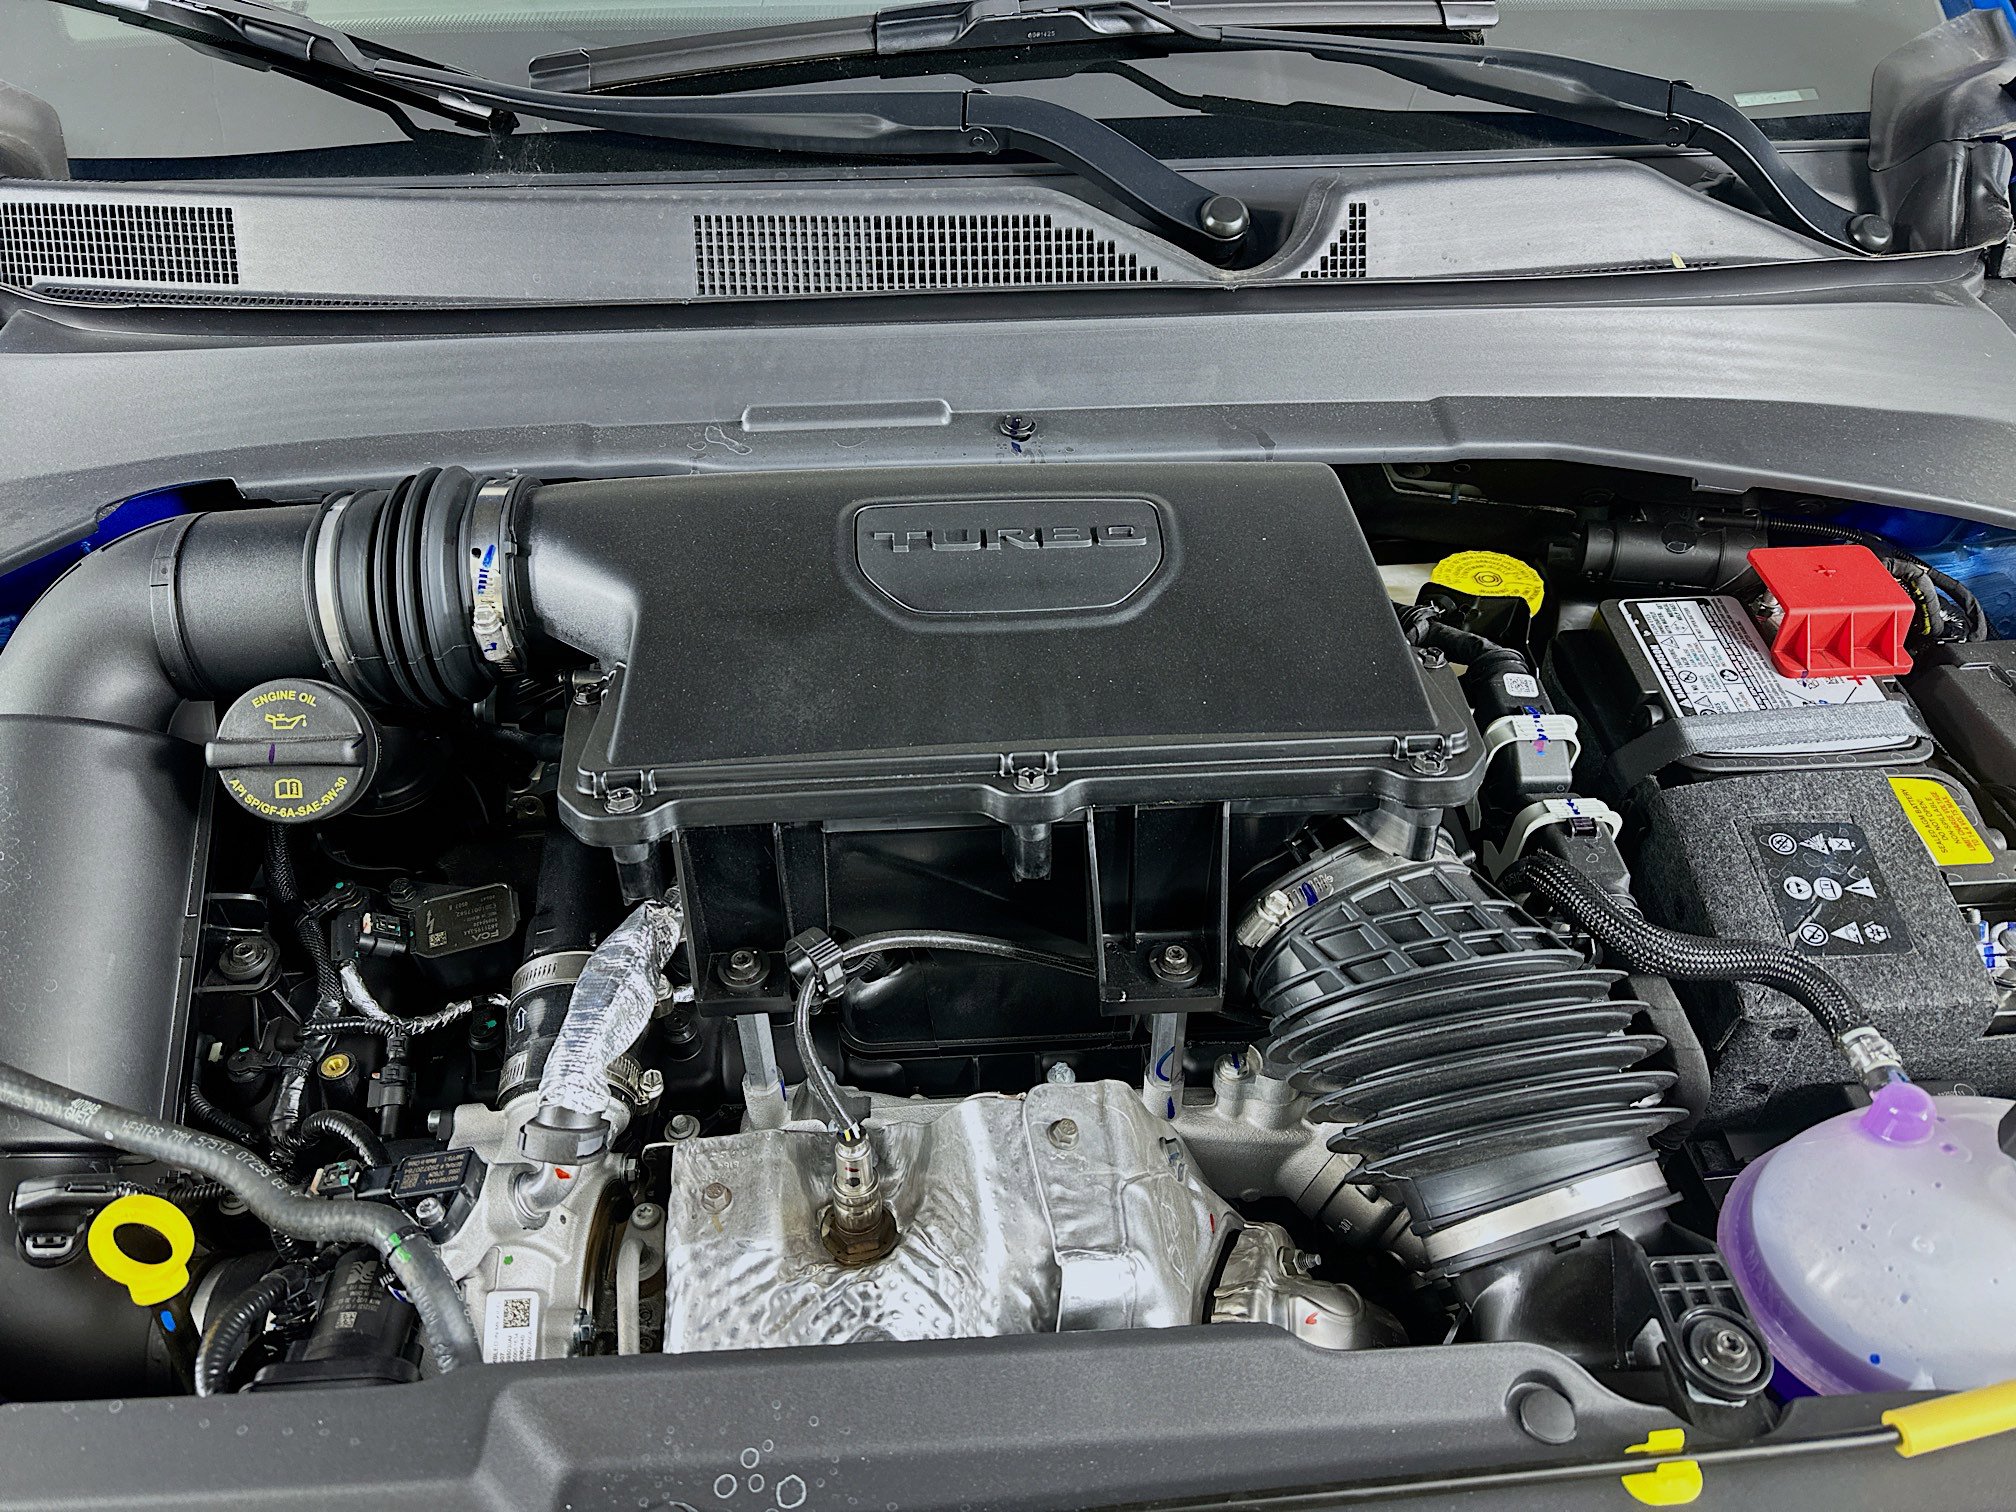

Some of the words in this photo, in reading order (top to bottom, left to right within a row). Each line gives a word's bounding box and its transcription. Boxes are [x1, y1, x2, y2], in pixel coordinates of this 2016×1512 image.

[873, 525, 1148, 552] TURBO
[1648, 644, 1687, 698] DANGER/POISON
[251, 690, 296, 709] ENGINE
[298, 691, 318, 708] OIL
[229, 777, 248, 798] API
[244, 775, 349, 818] SP/GF-6A-SAE-5W-30
[1900, 788, 1921, 813] BATTERY
[1918, 815, 1930, 827] AGM
[1929, 818, 1940, 830] NOT
[1927, 829, 1947, 852] SEALED
[1938, 831, 1947, 840] DO
[472, 929, 499, 942] FCA
[121, 1119, 164, 1139] HEATER
[193, 1134, 236, 1155] 57512
[235, 1150, 273, 1179] 07255
